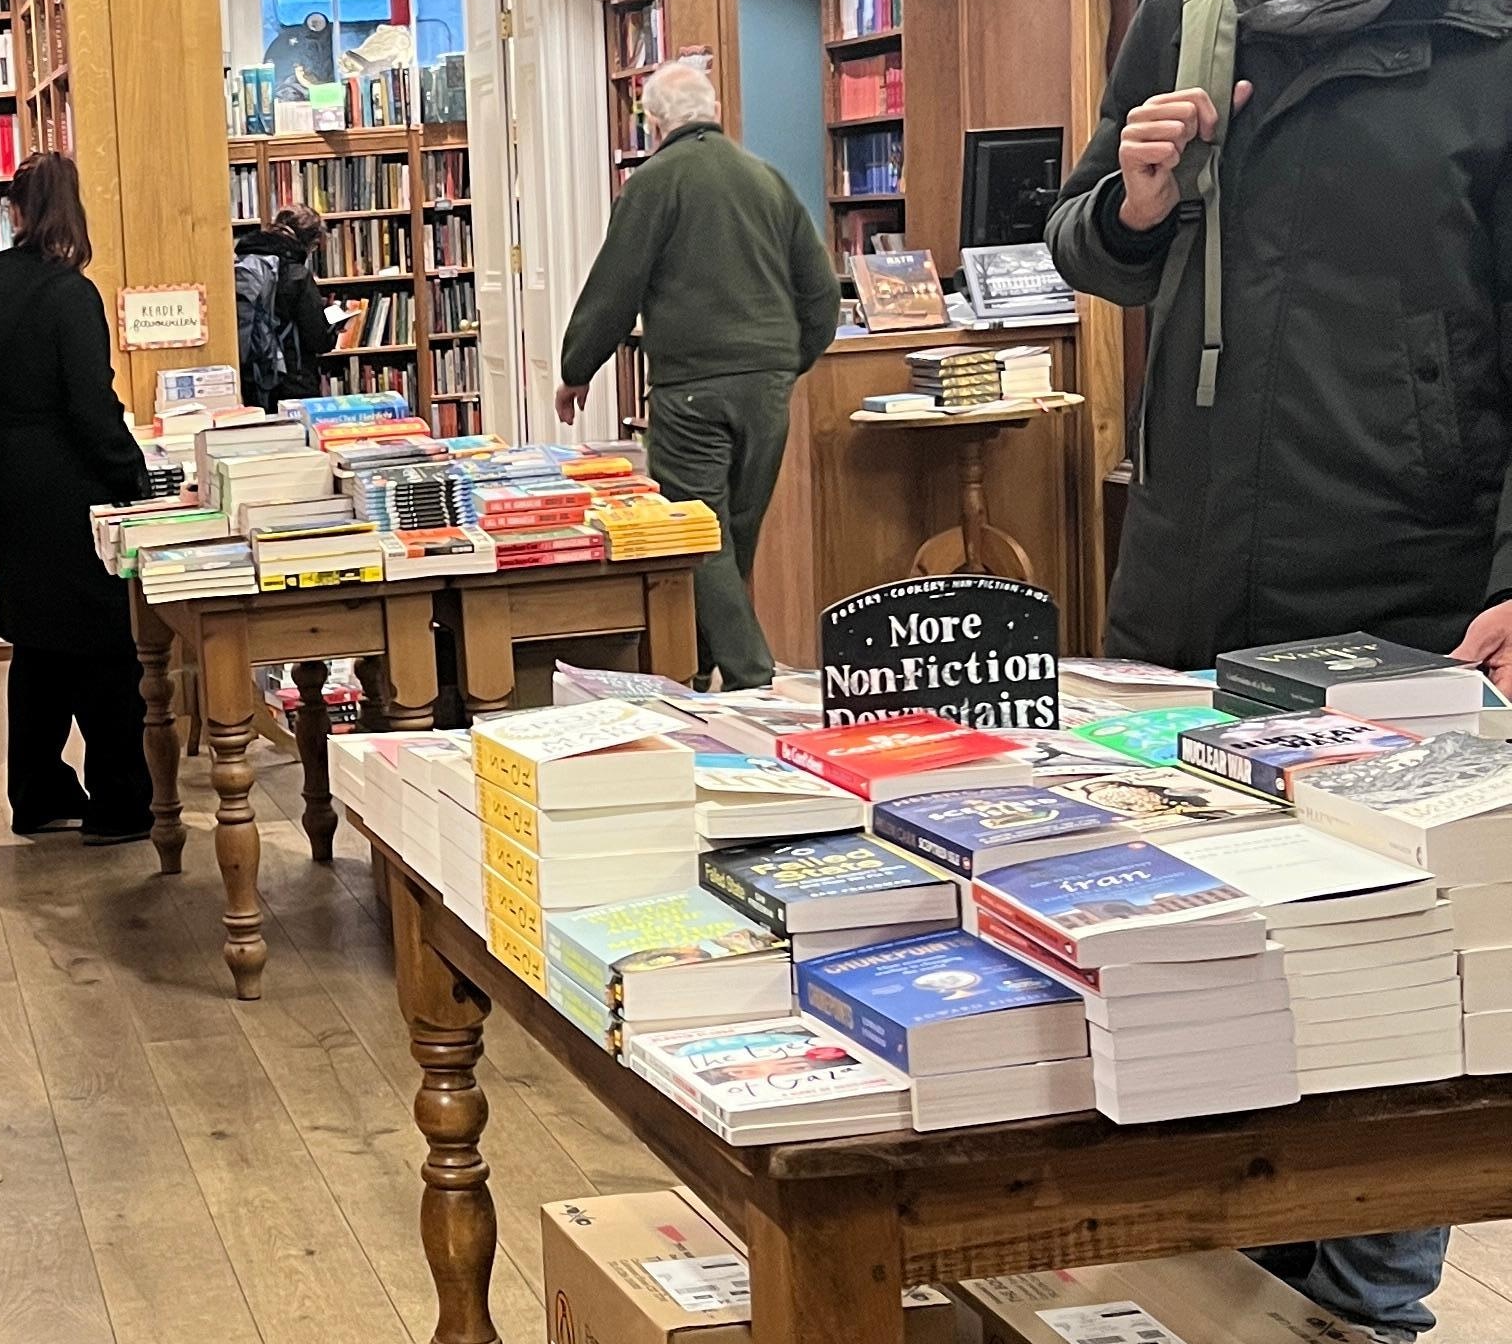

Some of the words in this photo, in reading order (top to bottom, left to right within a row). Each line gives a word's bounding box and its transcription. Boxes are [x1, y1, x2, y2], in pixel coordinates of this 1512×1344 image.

[142, 304, 185, 317] READER
[830, 592, 883, 626] POETRY
[889, 579, 947, 599] COOKERY
[887, 611, 983, 649] More
[824, 650, 1057, 699] Non-Fiction
[1182, 737, 1227, 776] NUCLEAR
[1227, 754, 1252, 785] WAR
[750, 847, 876, 875] Failed
[772, 859, 885, 882] State
[687, 1053, 731, 1070] The
[726, 1079, 757, 1098] of
